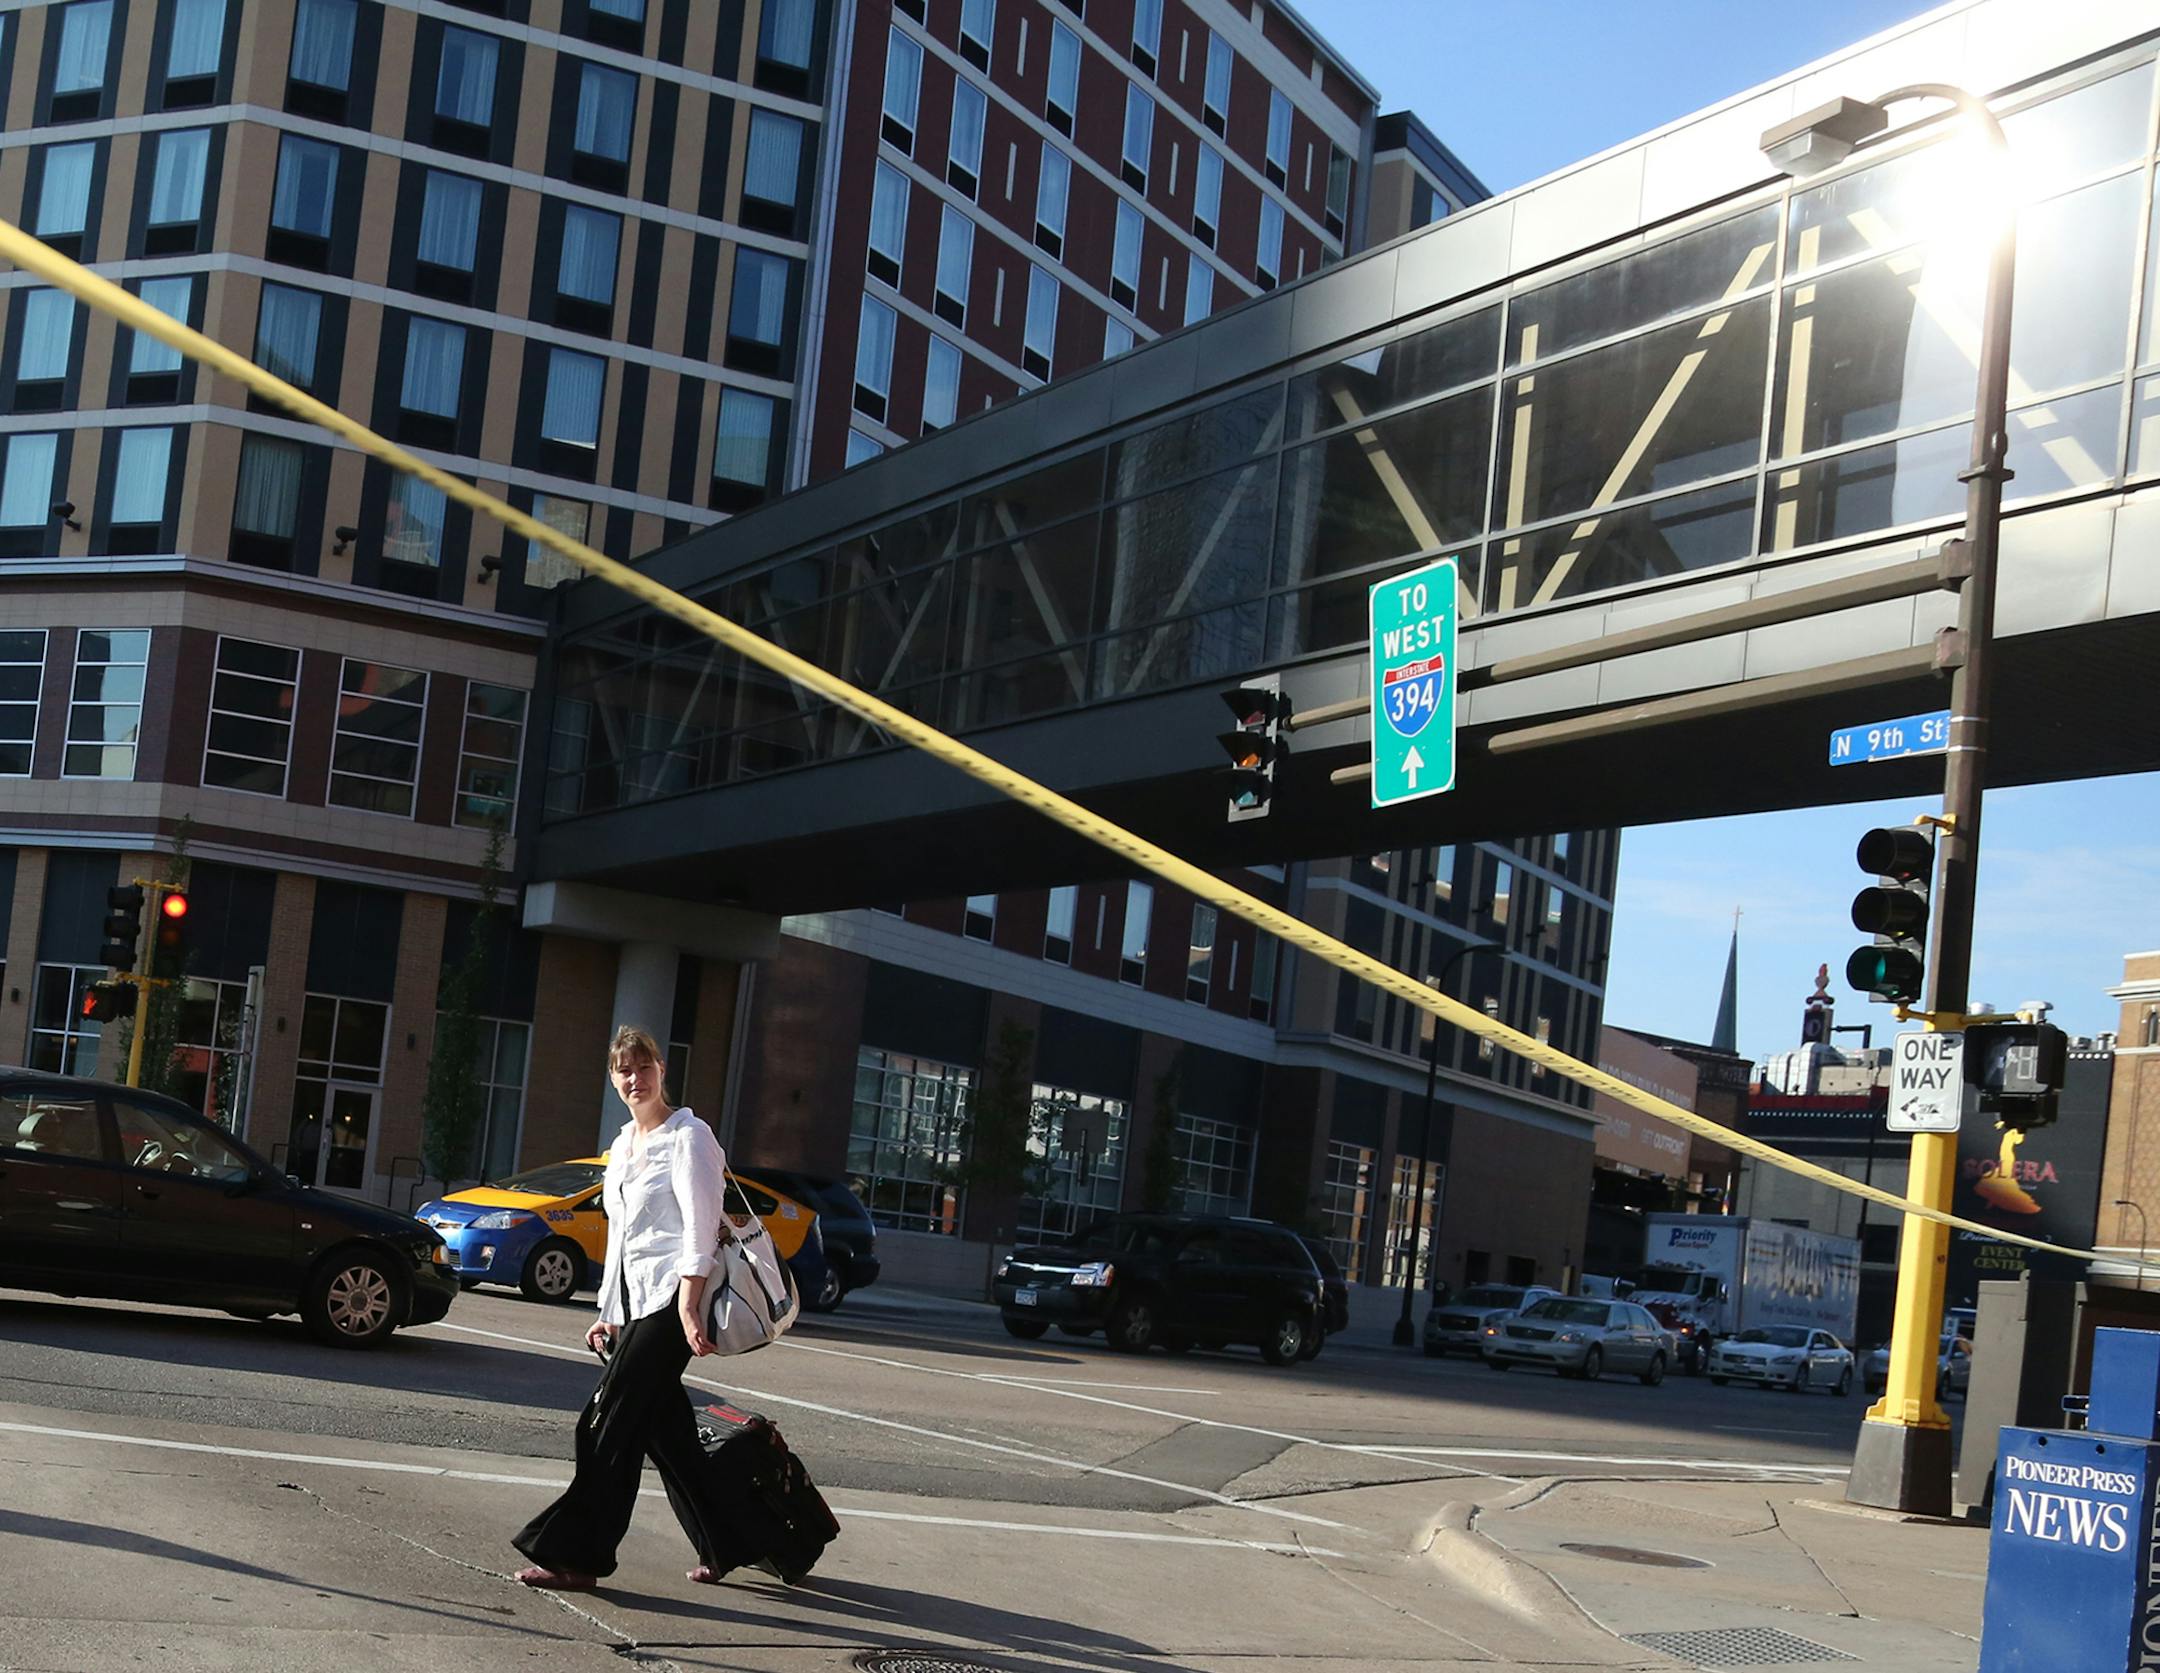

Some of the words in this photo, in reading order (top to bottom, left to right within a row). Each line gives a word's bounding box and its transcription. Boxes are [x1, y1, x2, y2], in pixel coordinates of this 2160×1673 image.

[1398, 583, 1427, 616] TO
[1383, 614, 1445, 659] WEST
[1395, 660, 1431, 680] INTERSTATE
[1391, 677, 1434, 722] 394
[1836, 735, 1851, 758] N
[1867, 726, 1903, 751] 9th
[1920, 719, 1944, 743] St
[1904, 1039, 1954, 1061] ONE
[1900, 1067, 1952, 1090] WAY
[545, 1209, 576, 1222] 3635
[1668, 1228, 1717, 1247] Priority
[1980, 1245, 2024, 1259] EVENT
[1973, 1257, 2027, 1271] CENTER
[2005, 1456, 2080, 1488] PIONEER
[2082, 1466, 2136, 1495] PRESS
[2004, 1488, 2129, 1553] NEWS
